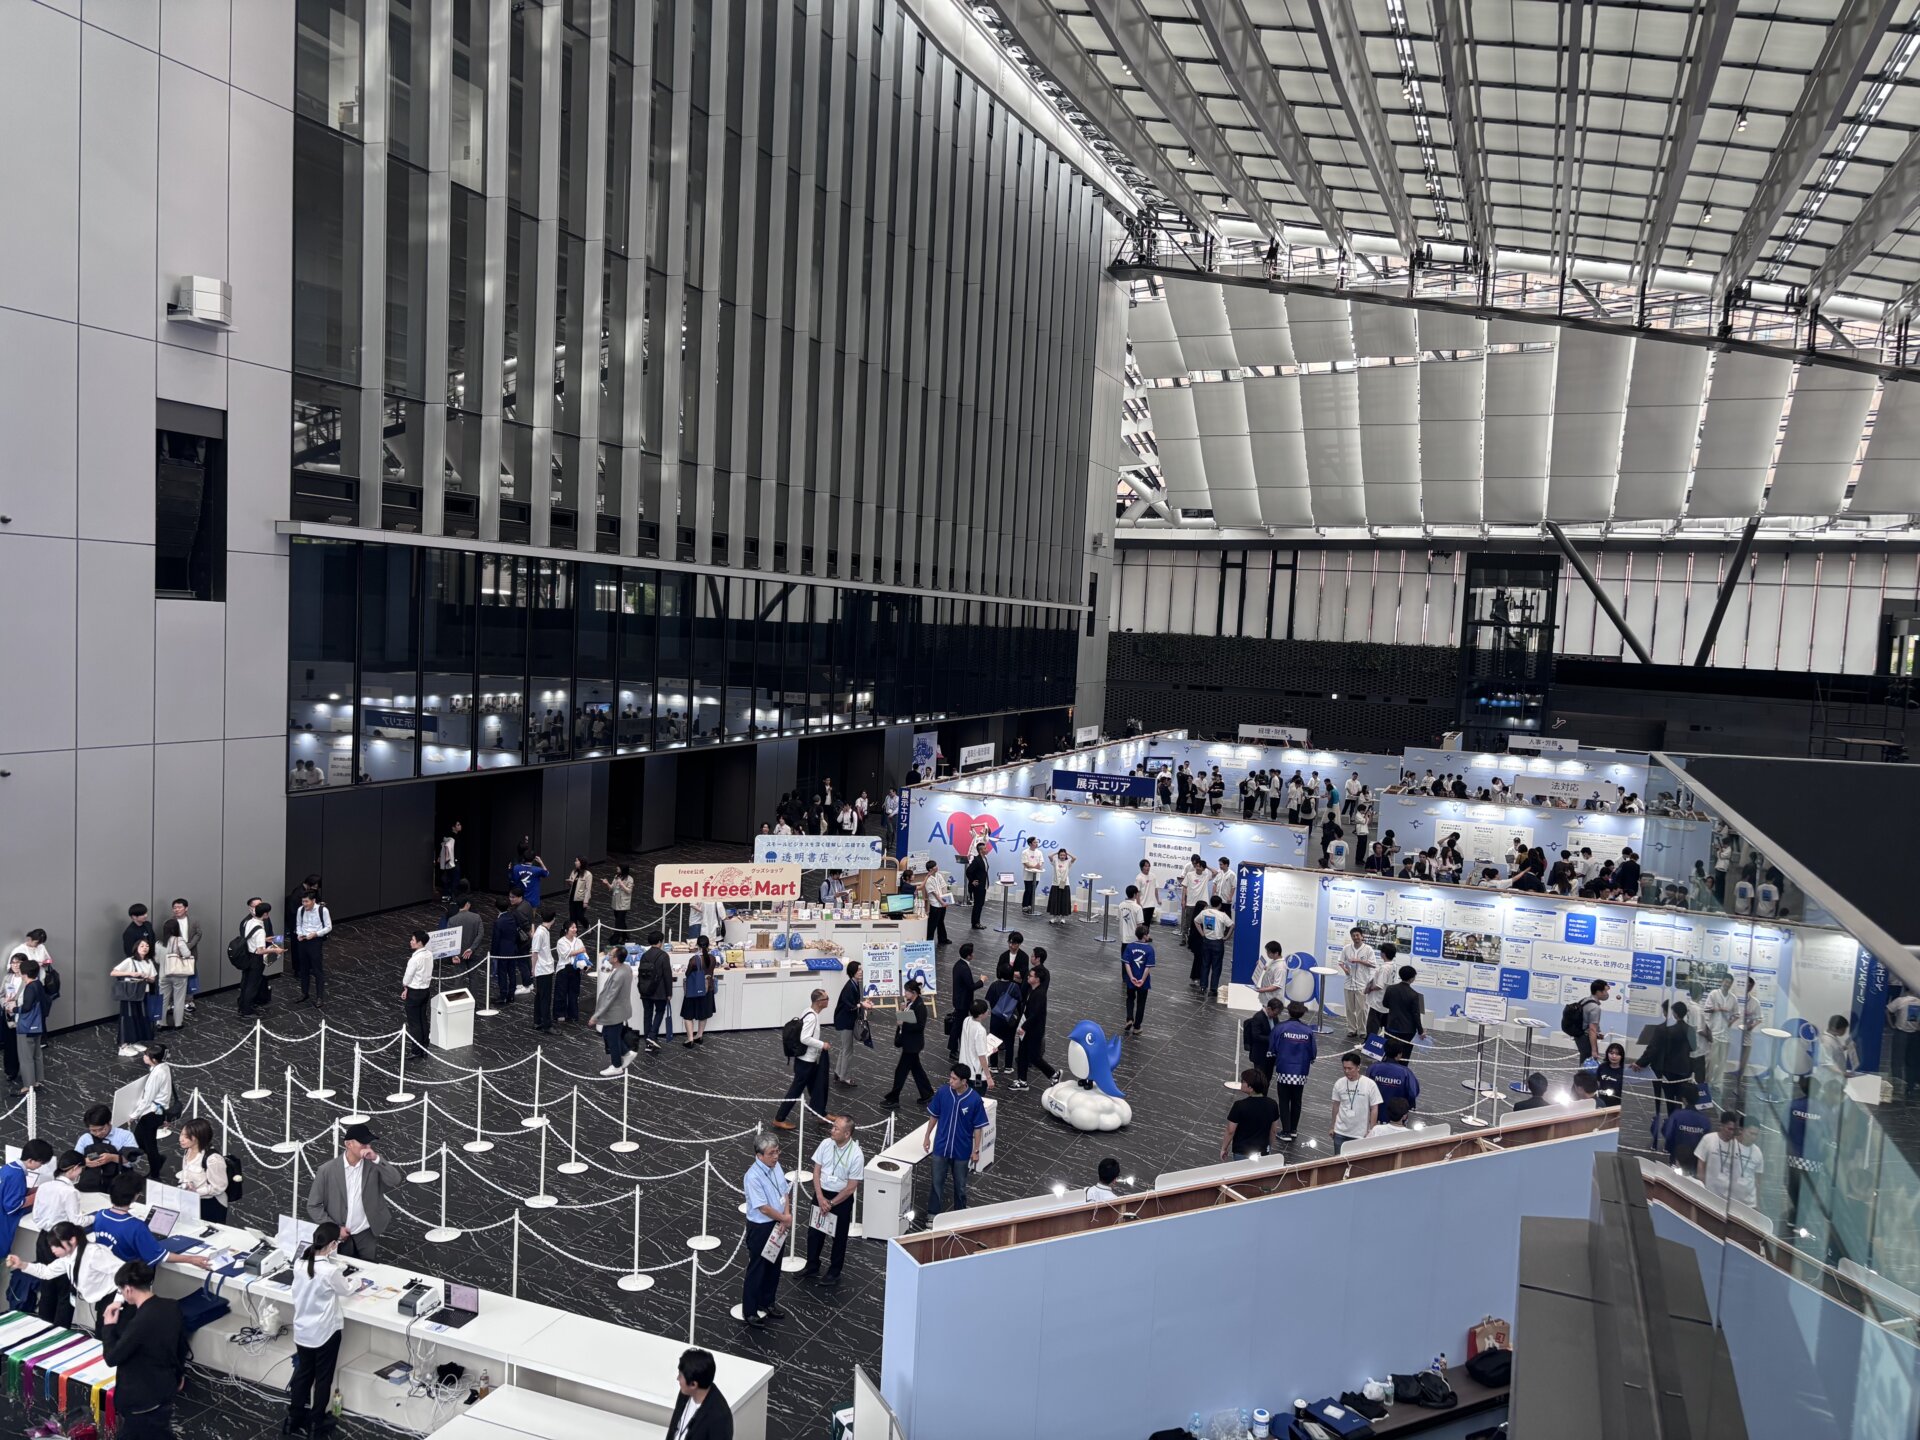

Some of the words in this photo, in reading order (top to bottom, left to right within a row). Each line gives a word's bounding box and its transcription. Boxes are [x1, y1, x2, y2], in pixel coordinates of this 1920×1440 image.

[1076, 777, 1131, 793] 展示エリア
[1551, 781, 1579, 792] 法対応
[900, 790, 909, 831] 展示エリア
[928, 821, 953, 846] AI
[782, 852, 829, 863] 透明書店
[1149, 852, 1191, 861] 取引先ごとのルール対
[660, 881, 698, 897] Feel
[703, 882, 750, 897] freee
[754, 880, 796, 896] Mart
[1240, 878, 1248, 912] 展示エリア
[1251, 880, 1260, 926] メインステージ
[1283, 1032, 1308, 1040] MIZUHO
[1374, 1075, 1401, 1085] MIZUHO
